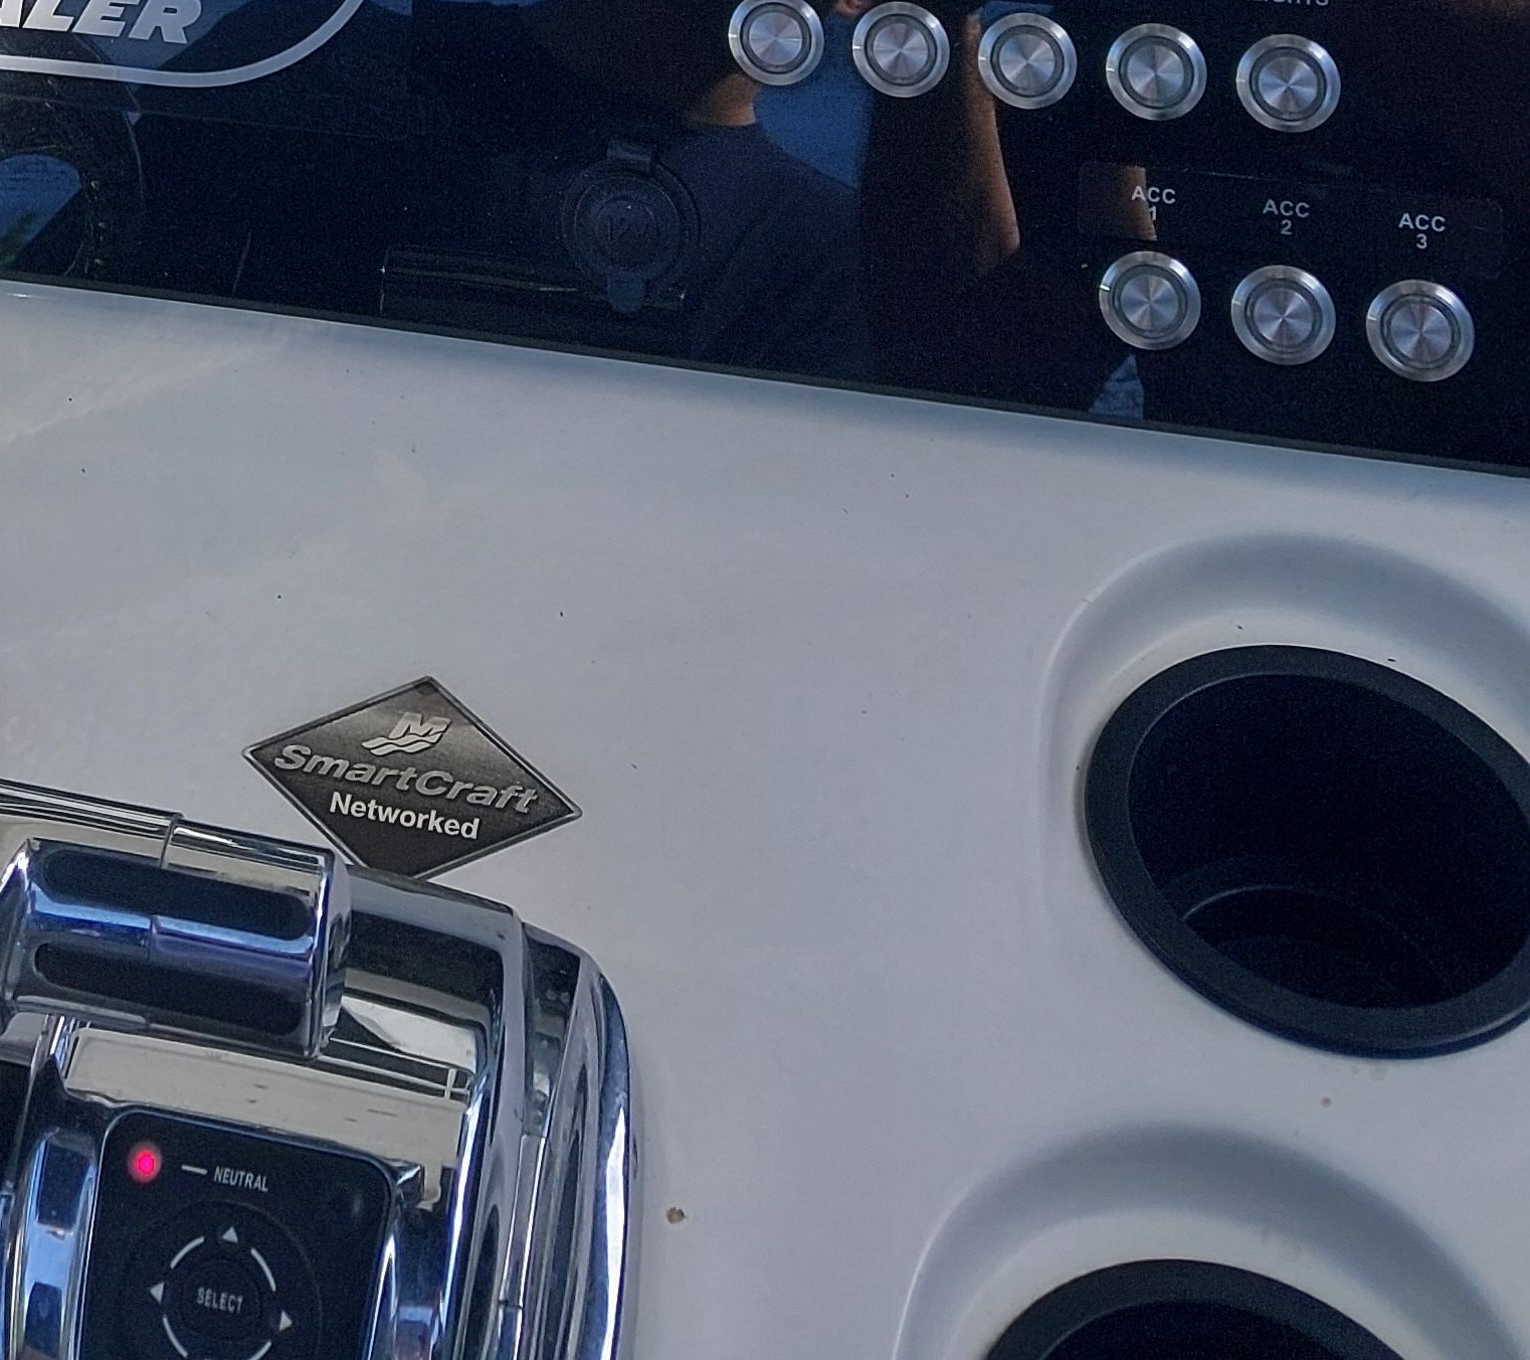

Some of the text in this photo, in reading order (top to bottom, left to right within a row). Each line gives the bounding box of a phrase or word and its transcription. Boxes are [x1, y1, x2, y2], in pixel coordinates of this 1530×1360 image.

[1131, 185, 1176, 204] ACC
[1148, 205, 1157, 221] 1
[1262, 199, 1310, 218] ACC
[1281, 219, 1292, 235] 2
[1398, 212, 1446, 232] ACC
[1416, 234, 1428, 249] 3
[274, 744, 539, 814] SmartCraft
[329, 791, 480, 840] Networked
[214, 1166, 269, 1193] NEUTRAL
[196, 1287, 244, 1314] SELECT
